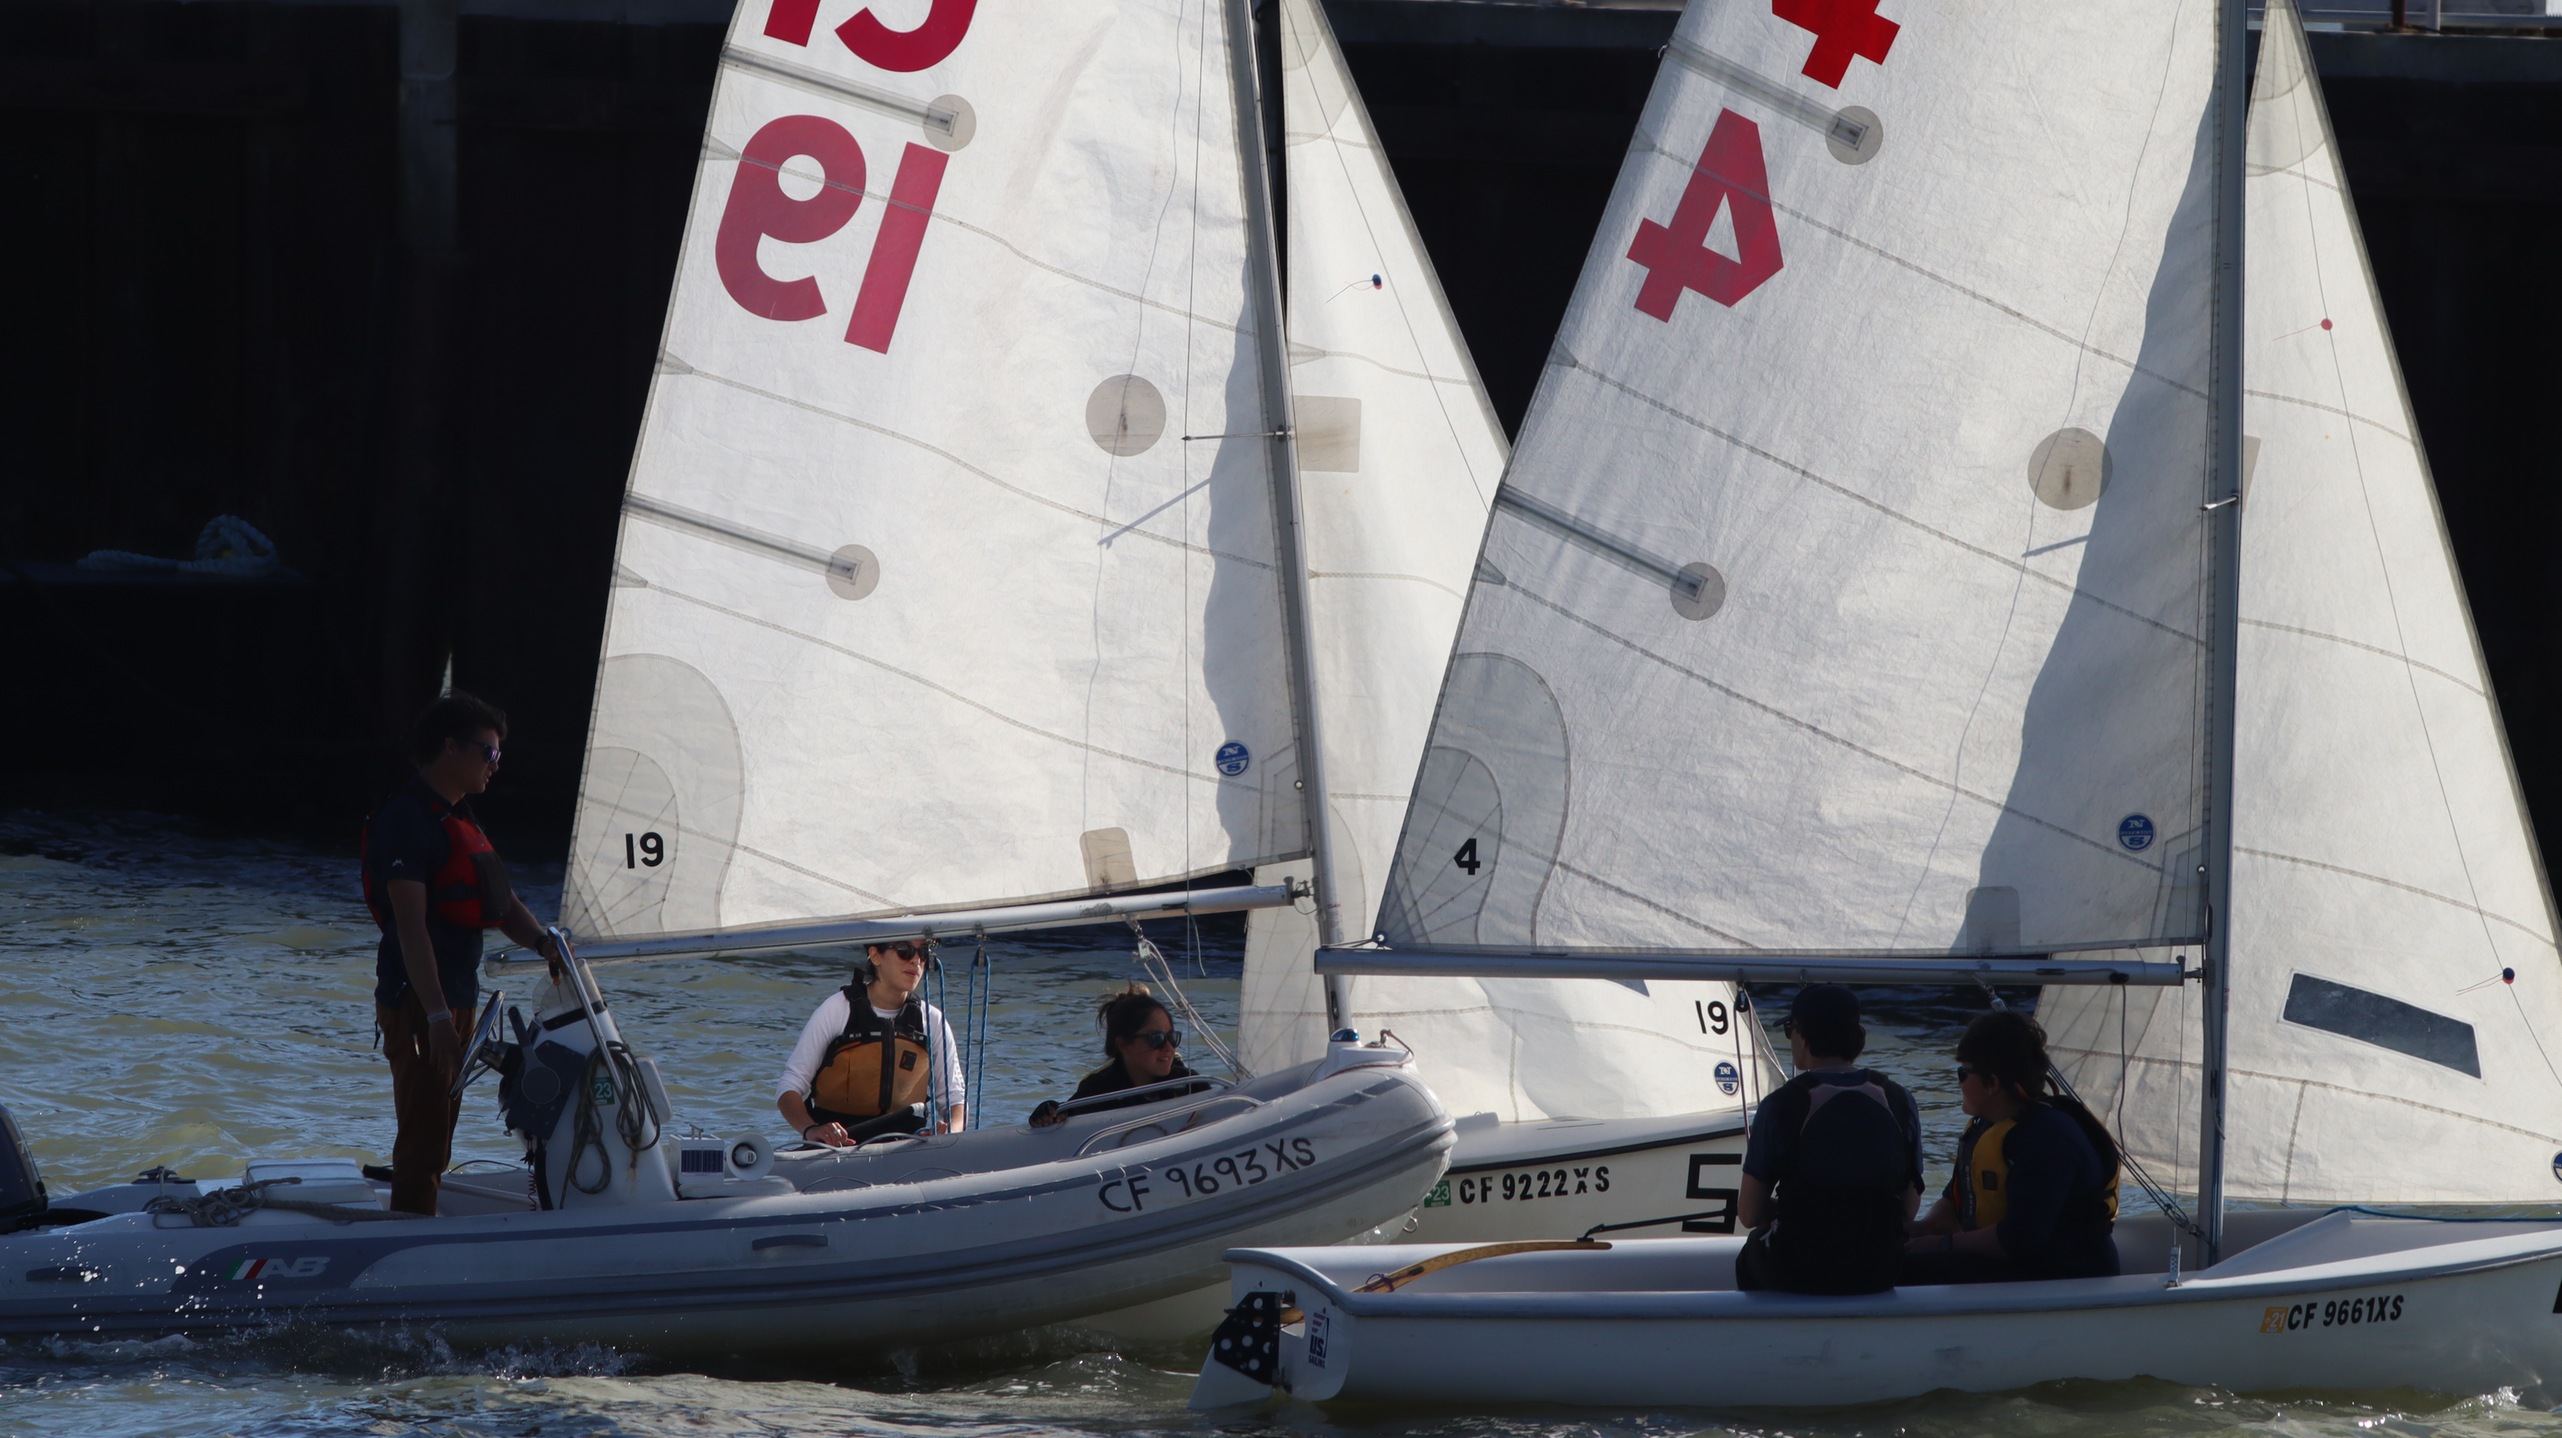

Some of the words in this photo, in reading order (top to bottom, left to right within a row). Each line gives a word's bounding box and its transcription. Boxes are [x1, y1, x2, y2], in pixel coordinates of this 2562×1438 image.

[625, 831, 664, 869] 19
[1453, 837, 1481, 876] 4
[1695, 1000, 1729, 1035] 19
[595, 1082, 613, 1099] 23
[1098, 1175, 1150, 1212] CF
[1432, 1185, 1450, 1201] 23
[1459, 1177, 1493, 1205] CF
[1502, 1166, 1610, 1201] 9222XS
[255, 1256, 331, 1279] AB
[2269, 1311, 2286, 1328] 21
[2287, 1302, 2318, 1331] CF
[2323, 1294, 2405, 1328] 9661XS
[1309, 1334, 1325, 1358] US
